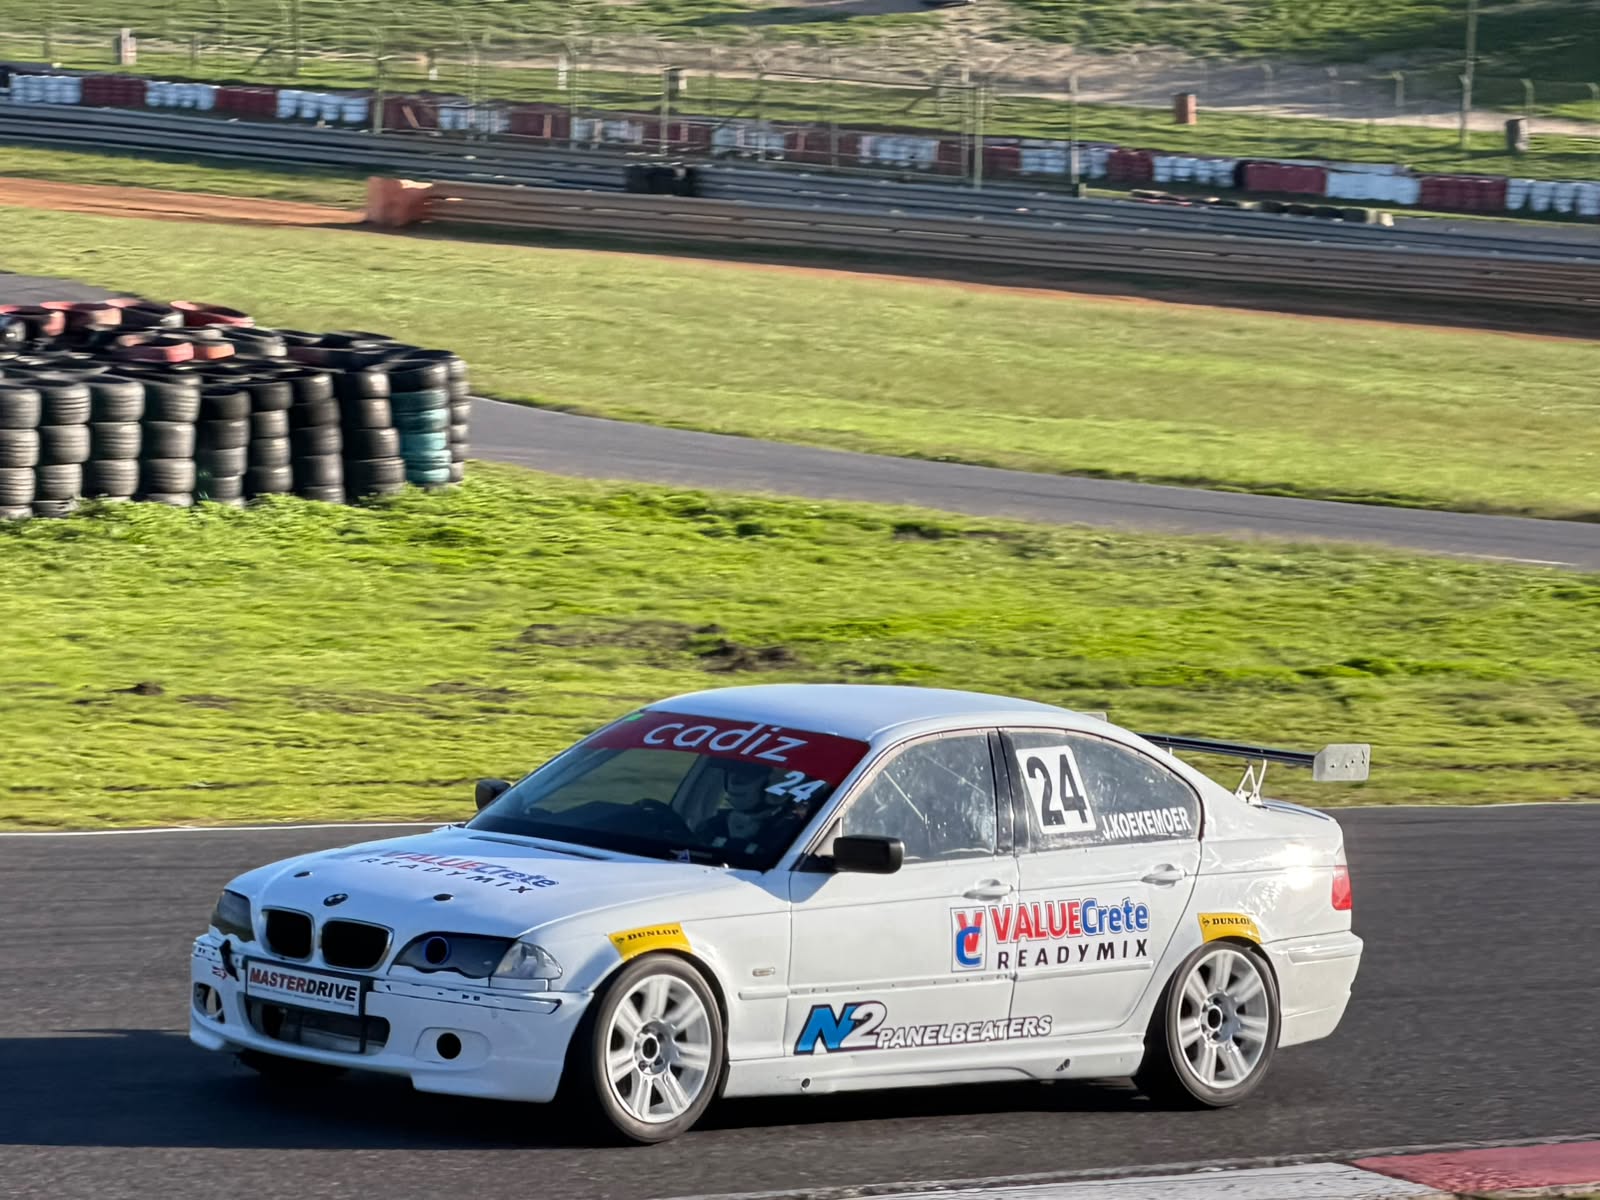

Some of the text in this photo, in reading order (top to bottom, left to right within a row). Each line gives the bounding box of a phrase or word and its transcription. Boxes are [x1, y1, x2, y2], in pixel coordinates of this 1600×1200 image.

[642, 722, 809, 763] cadiz
[765, 771, 826, 803] 24
[1026, 753, 1089, 826] 24
[1101, 806, 1192, 840] J.KOEKEMOER
[627, 928, 680, 941] DUNLOP
[989, 898, 1150, 943] VALUECrete
[997, 938, 1148, 970] READYMIX
[249, 967, 358, 1002] MASTERDRIVE
[794, 1000, 1053, 1055] N2 PANELBEATERS
